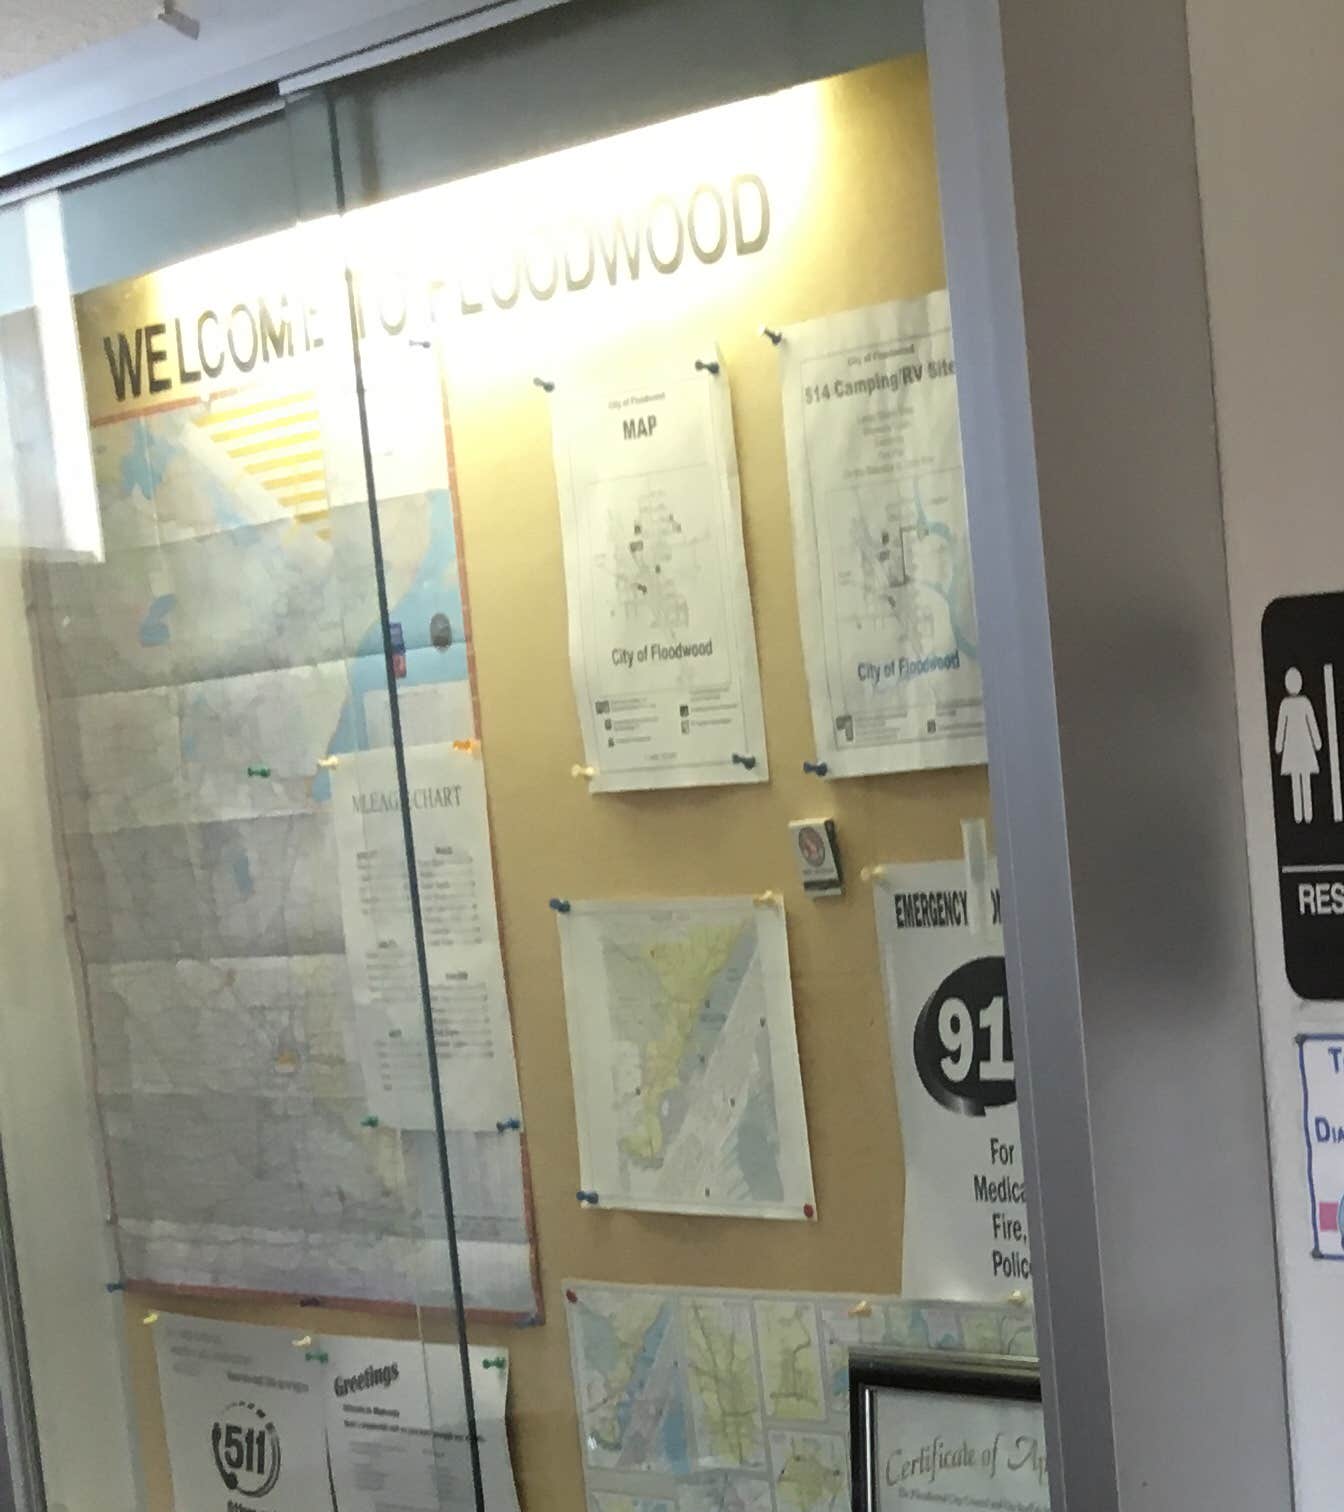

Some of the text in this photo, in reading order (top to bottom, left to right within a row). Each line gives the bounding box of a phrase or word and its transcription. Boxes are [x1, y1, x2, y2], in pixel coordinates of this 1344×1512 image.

[622, 414, 657, 440] MAP
[612, 639, 713, 668] City of Floodwood
[857, 661, 881, 687] City
[883, 660, 895, 678] of
[414, 784, 463, 809] CHART
[894, 889, 969, 929] EMERGENCY
[990, 1138, 1014, 1165] For
[992, 1212, 1027, 1245] Fire,
[992, 1249, 1032, 1280] Polic
[334, 1361, 400, 1397] Greetings
[224, 1423, 266, 1475] 511
[884, 1436, 975, 1487] Certificate
[981, 1431, 1005, 1480] of
